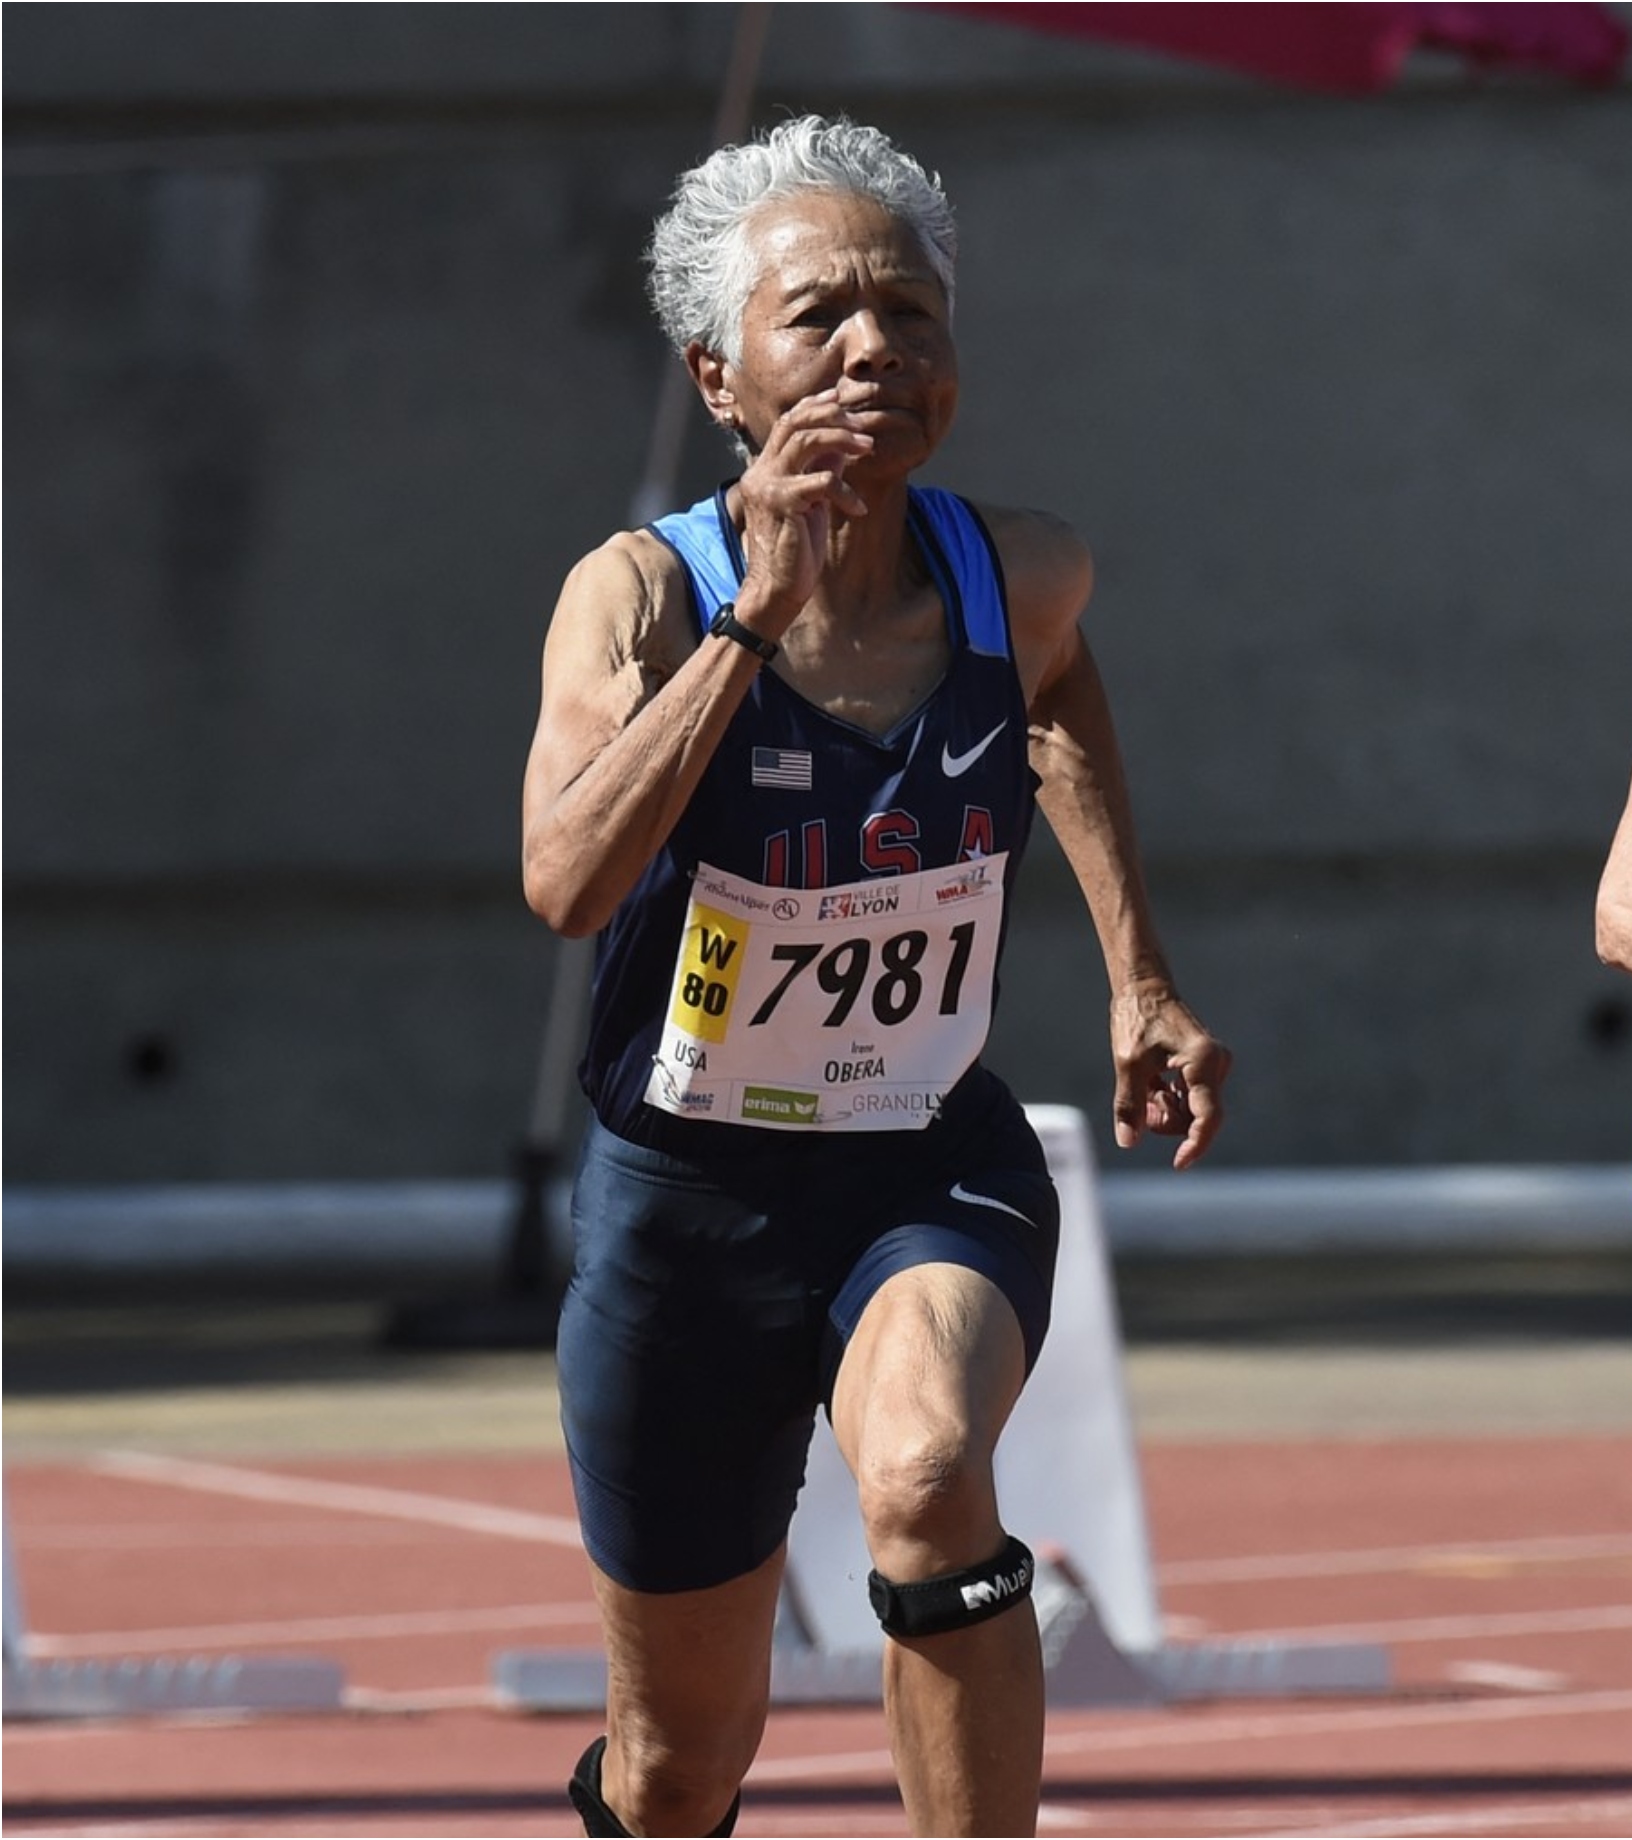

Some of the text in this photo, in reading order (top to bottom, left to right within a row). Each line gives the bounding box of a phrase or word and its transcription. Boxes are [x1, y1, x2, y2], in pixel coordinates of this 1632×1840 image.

[763, 803, 995, 890] USA
[851, 896, 900, 917] LYON
[853, 883, 900, 900] VILLE DE
[700, 926, 738, 971] W
[748, 920, 976, 1028] 7981
[682, 972, 729, 1017] 80
[675, 1039, 707, 1072] USA
[824, 1056, 886, 1083] OBERA
[744, 1092, 792, 1115] erima
